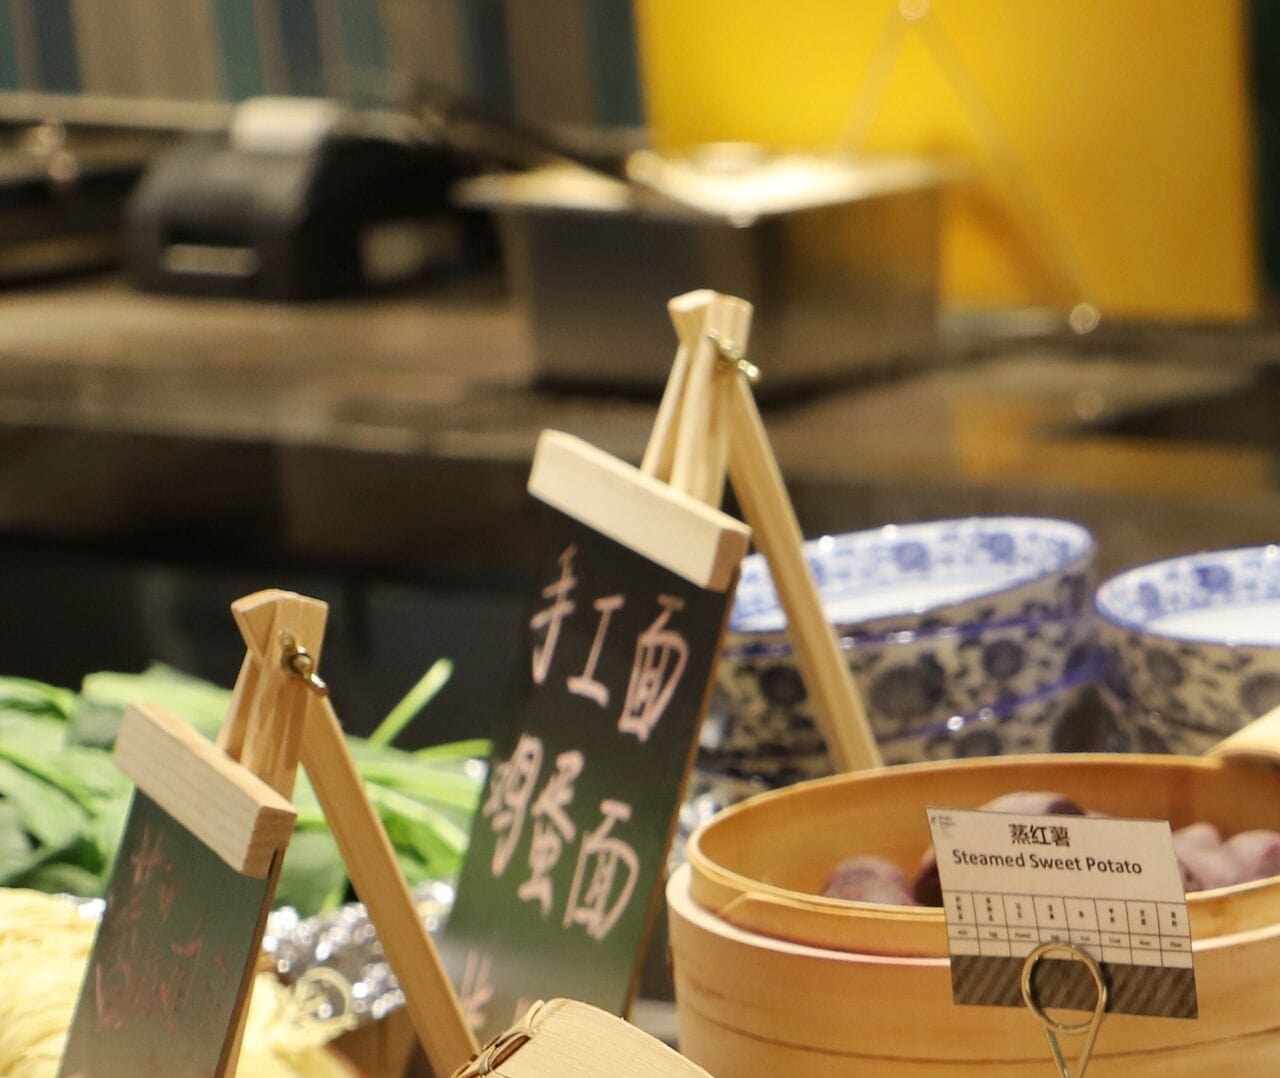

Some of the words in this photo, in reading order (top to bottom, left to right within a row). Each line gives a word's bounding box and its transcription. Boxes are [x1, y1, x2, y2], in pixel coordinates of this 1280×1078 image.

[1008, 823, 1071, 847] 蒸红薯
[952, 849, 1025, 868] Steamed
[1029, 853, 1082, 872] Sweet
[1086, 856, 1142, 875] Potato
